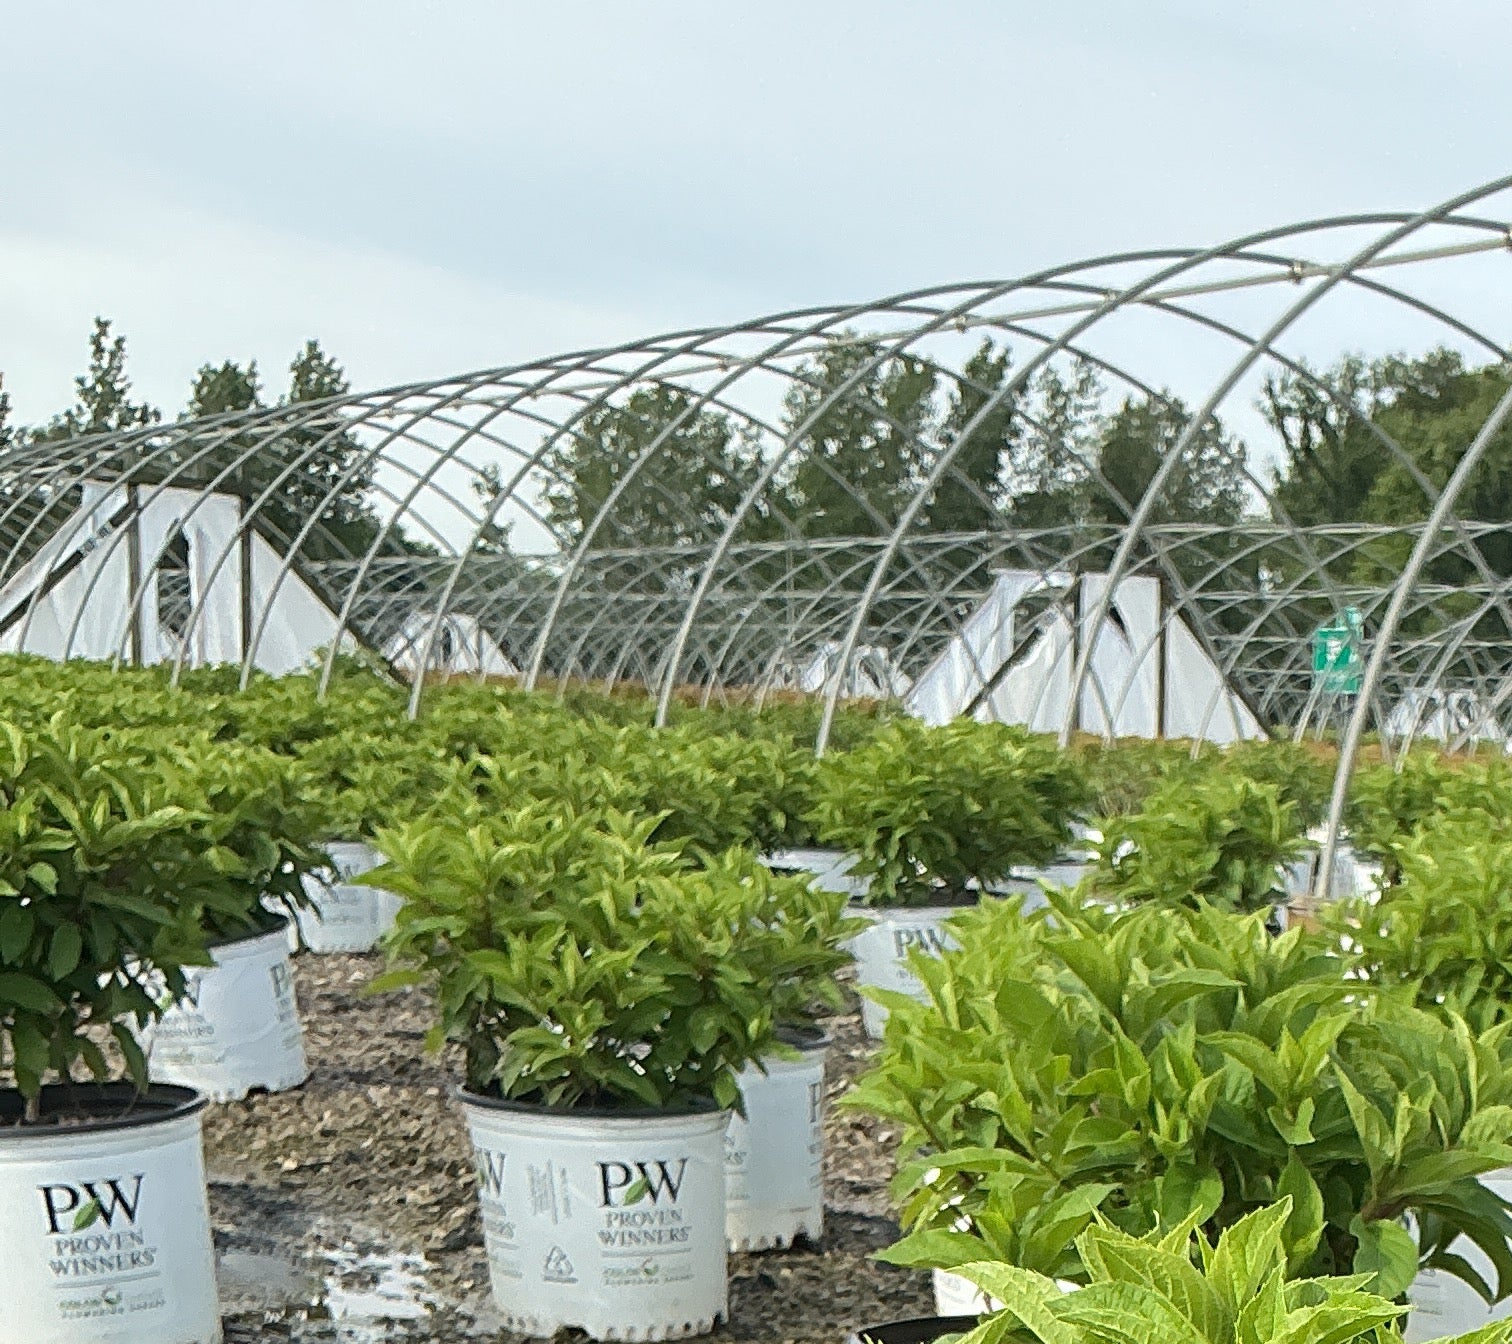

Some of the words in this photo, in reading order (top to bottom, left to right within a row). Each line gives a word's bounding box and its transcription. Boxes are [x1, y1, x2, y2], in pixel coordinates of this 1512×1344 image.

[596, 1157, 688, 1208] PW
[36, 1172, 145, 1236] PW
[606, 1208, 684, 1229] PROVEN
[55, 1229, 144, 1256] PROVEN
